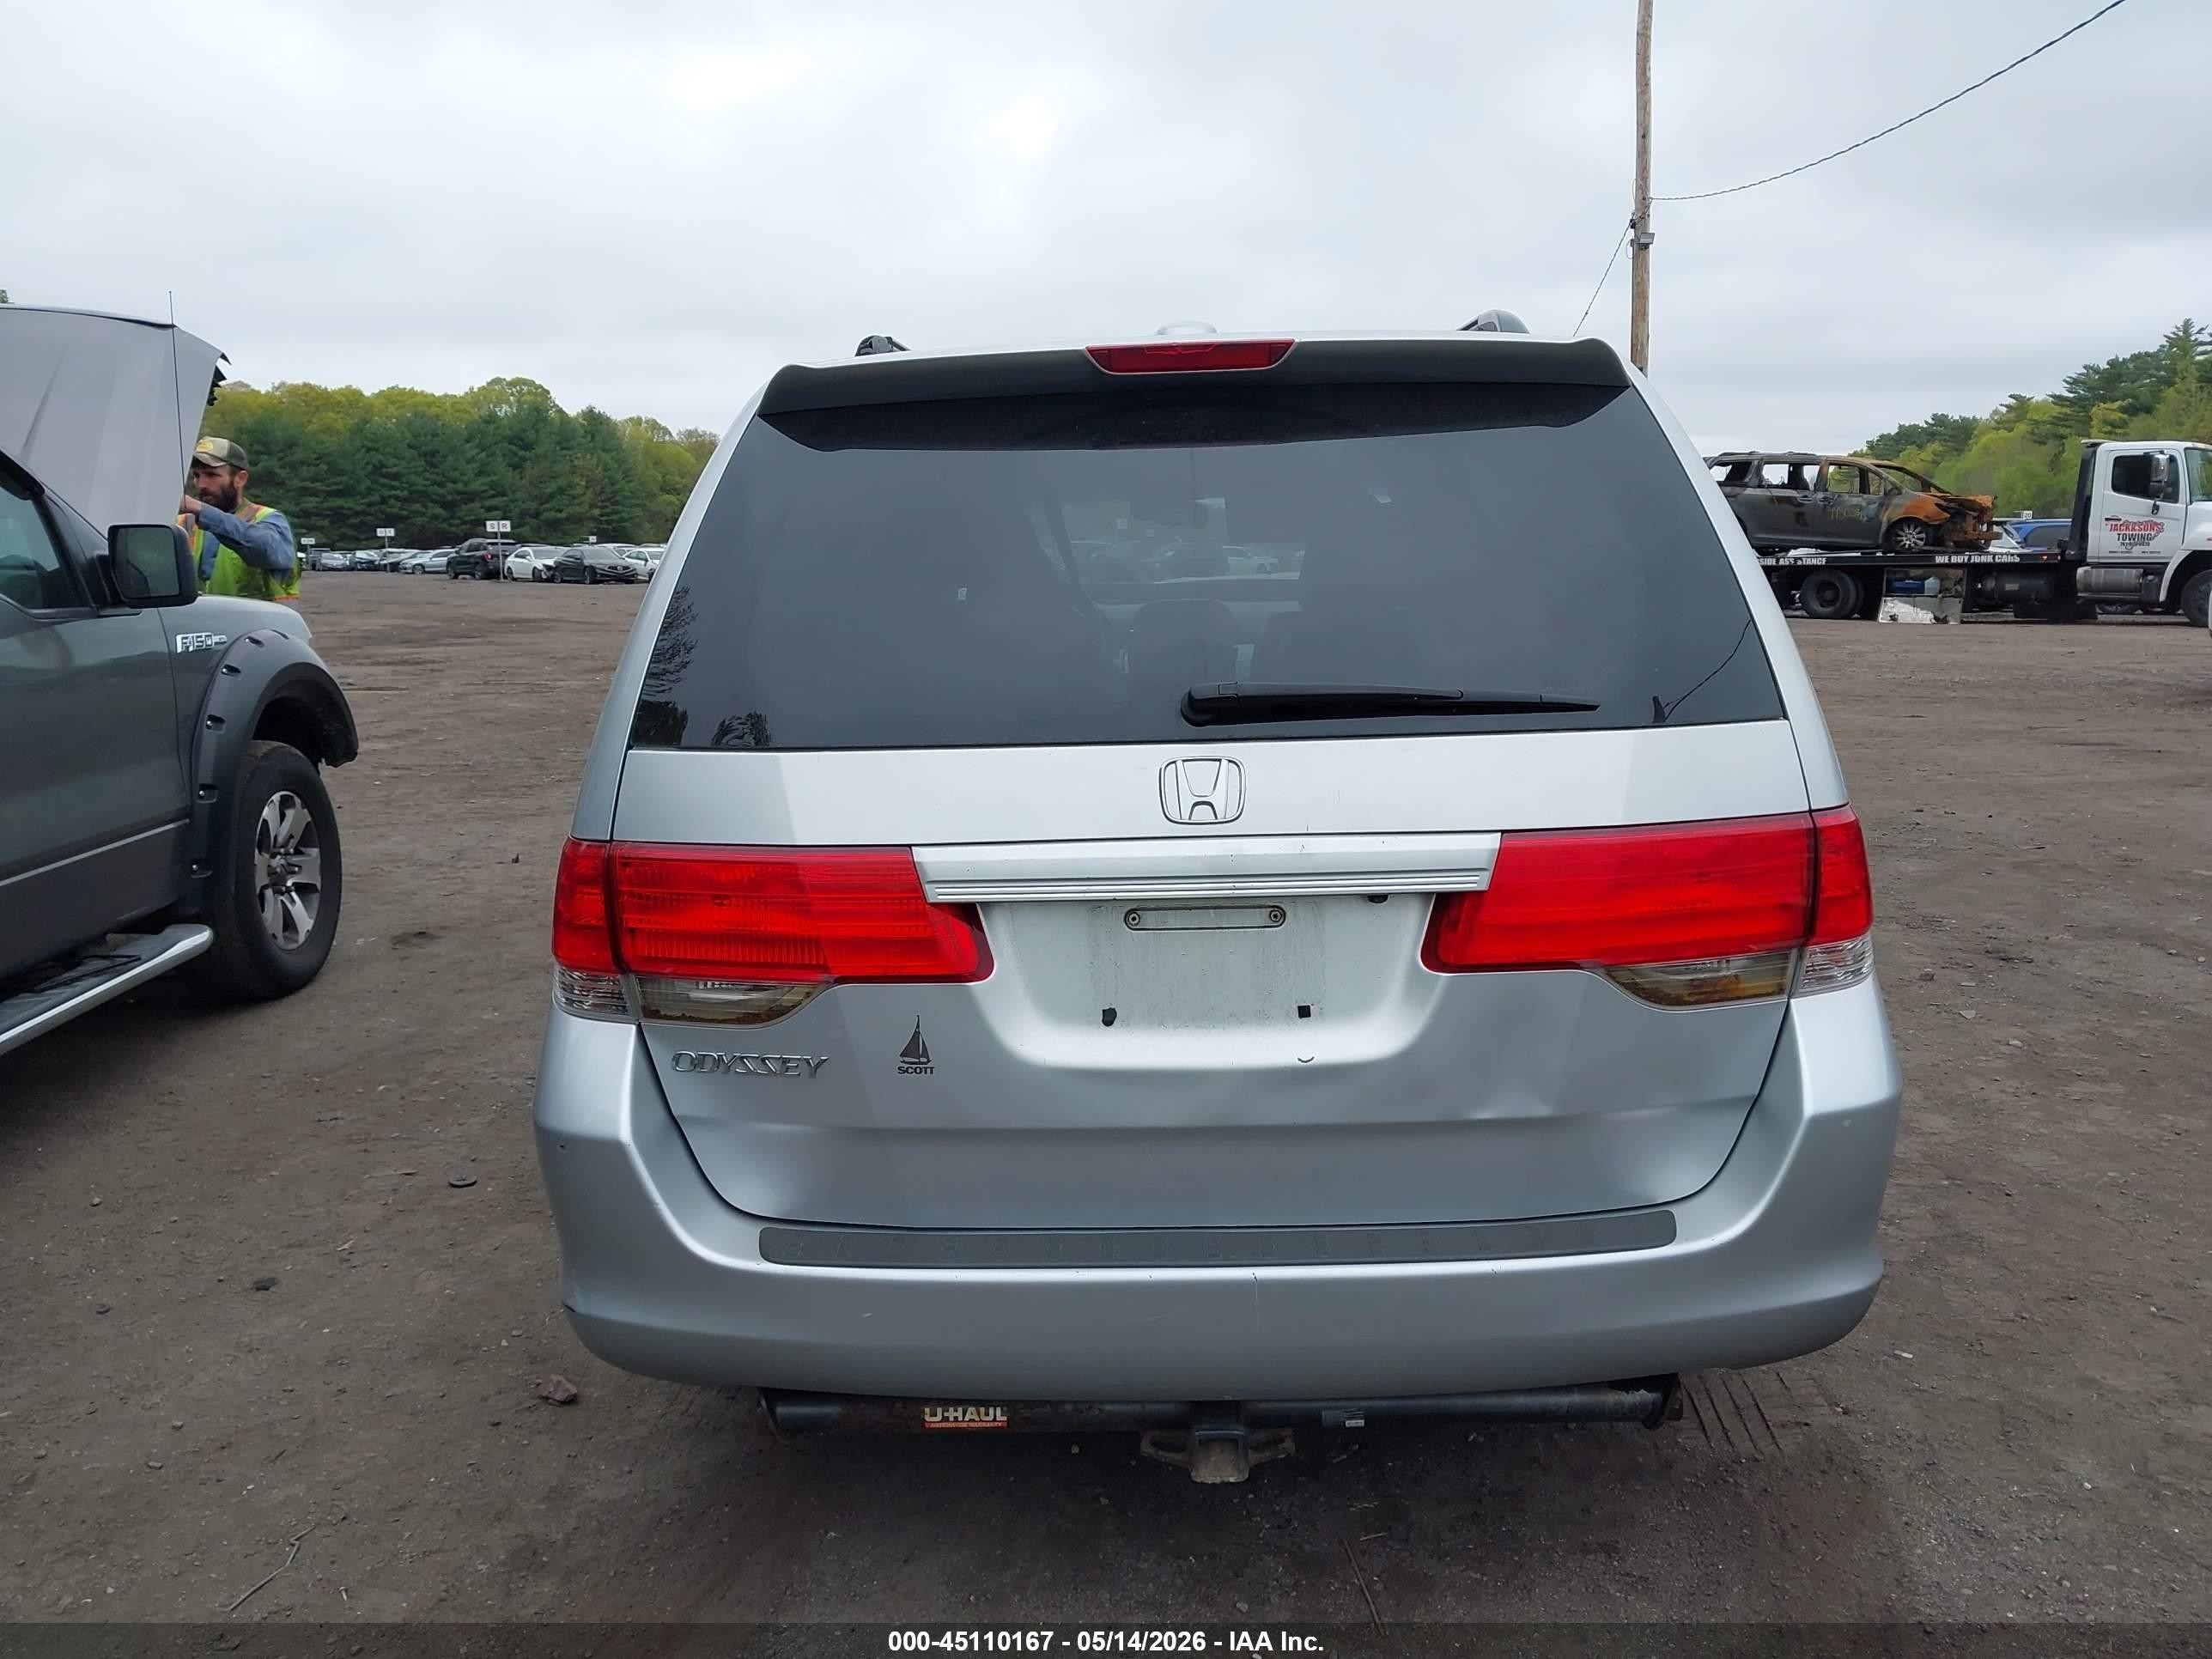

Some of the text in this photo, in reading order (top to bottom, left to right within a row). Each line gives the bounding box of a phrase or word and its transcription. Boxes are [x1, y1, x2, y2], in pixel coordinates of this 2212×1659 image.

[2117, 532, 2153, 542] TOWING
[1951, 555, 1968, 563] BUY
[672, 1050, 830, 1078] ODYSSEY
[897, 1066, 935, 1075] SCOTT
[924, 1407, 1007, 1422] U-HAUL
